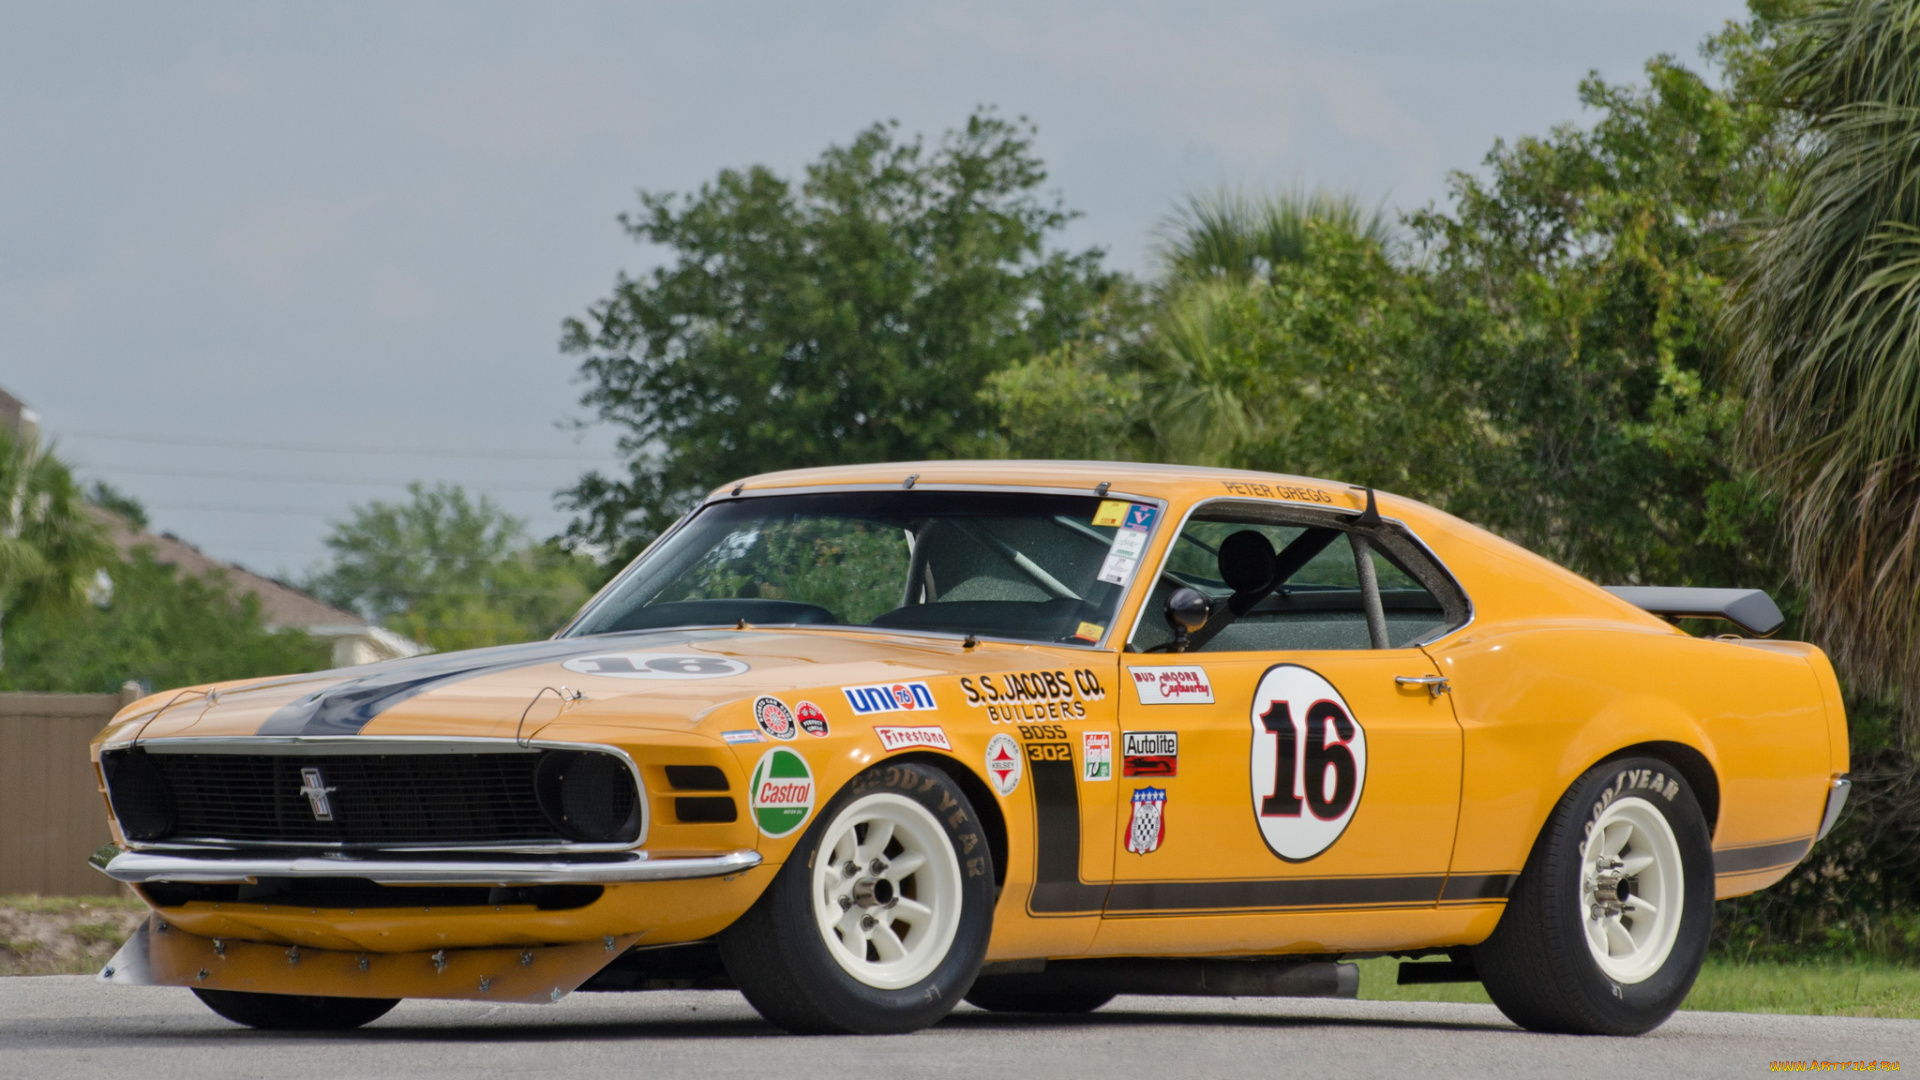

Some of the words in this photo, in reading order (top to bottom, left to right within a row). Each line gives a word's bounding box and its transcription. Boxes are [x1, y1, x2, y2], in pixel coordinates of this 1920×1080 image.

[1221, 481, 1275, 498] PETER
[1276, 485, 1333, 503] GREGG
[578, 657, 735, 674] 16
[1074, 669, 1106, 701] CO.
[1133, 672, 1156, 682] BUD
[896, 689, 912, 704] 76
[988, 701, 1087, 724] BUILDERS
[880, 729, 946, 746] Firestone
[1018, 725, 1067, 740] BOSS
[1028, 745, 1072, 761] 302
[1126, 735, 1175, 754] Autolite
[991, 761, 1015, 769] KELSEY
[1259, 698, 1357, 822] 16
[760, 782, 811, 803] Castrol
